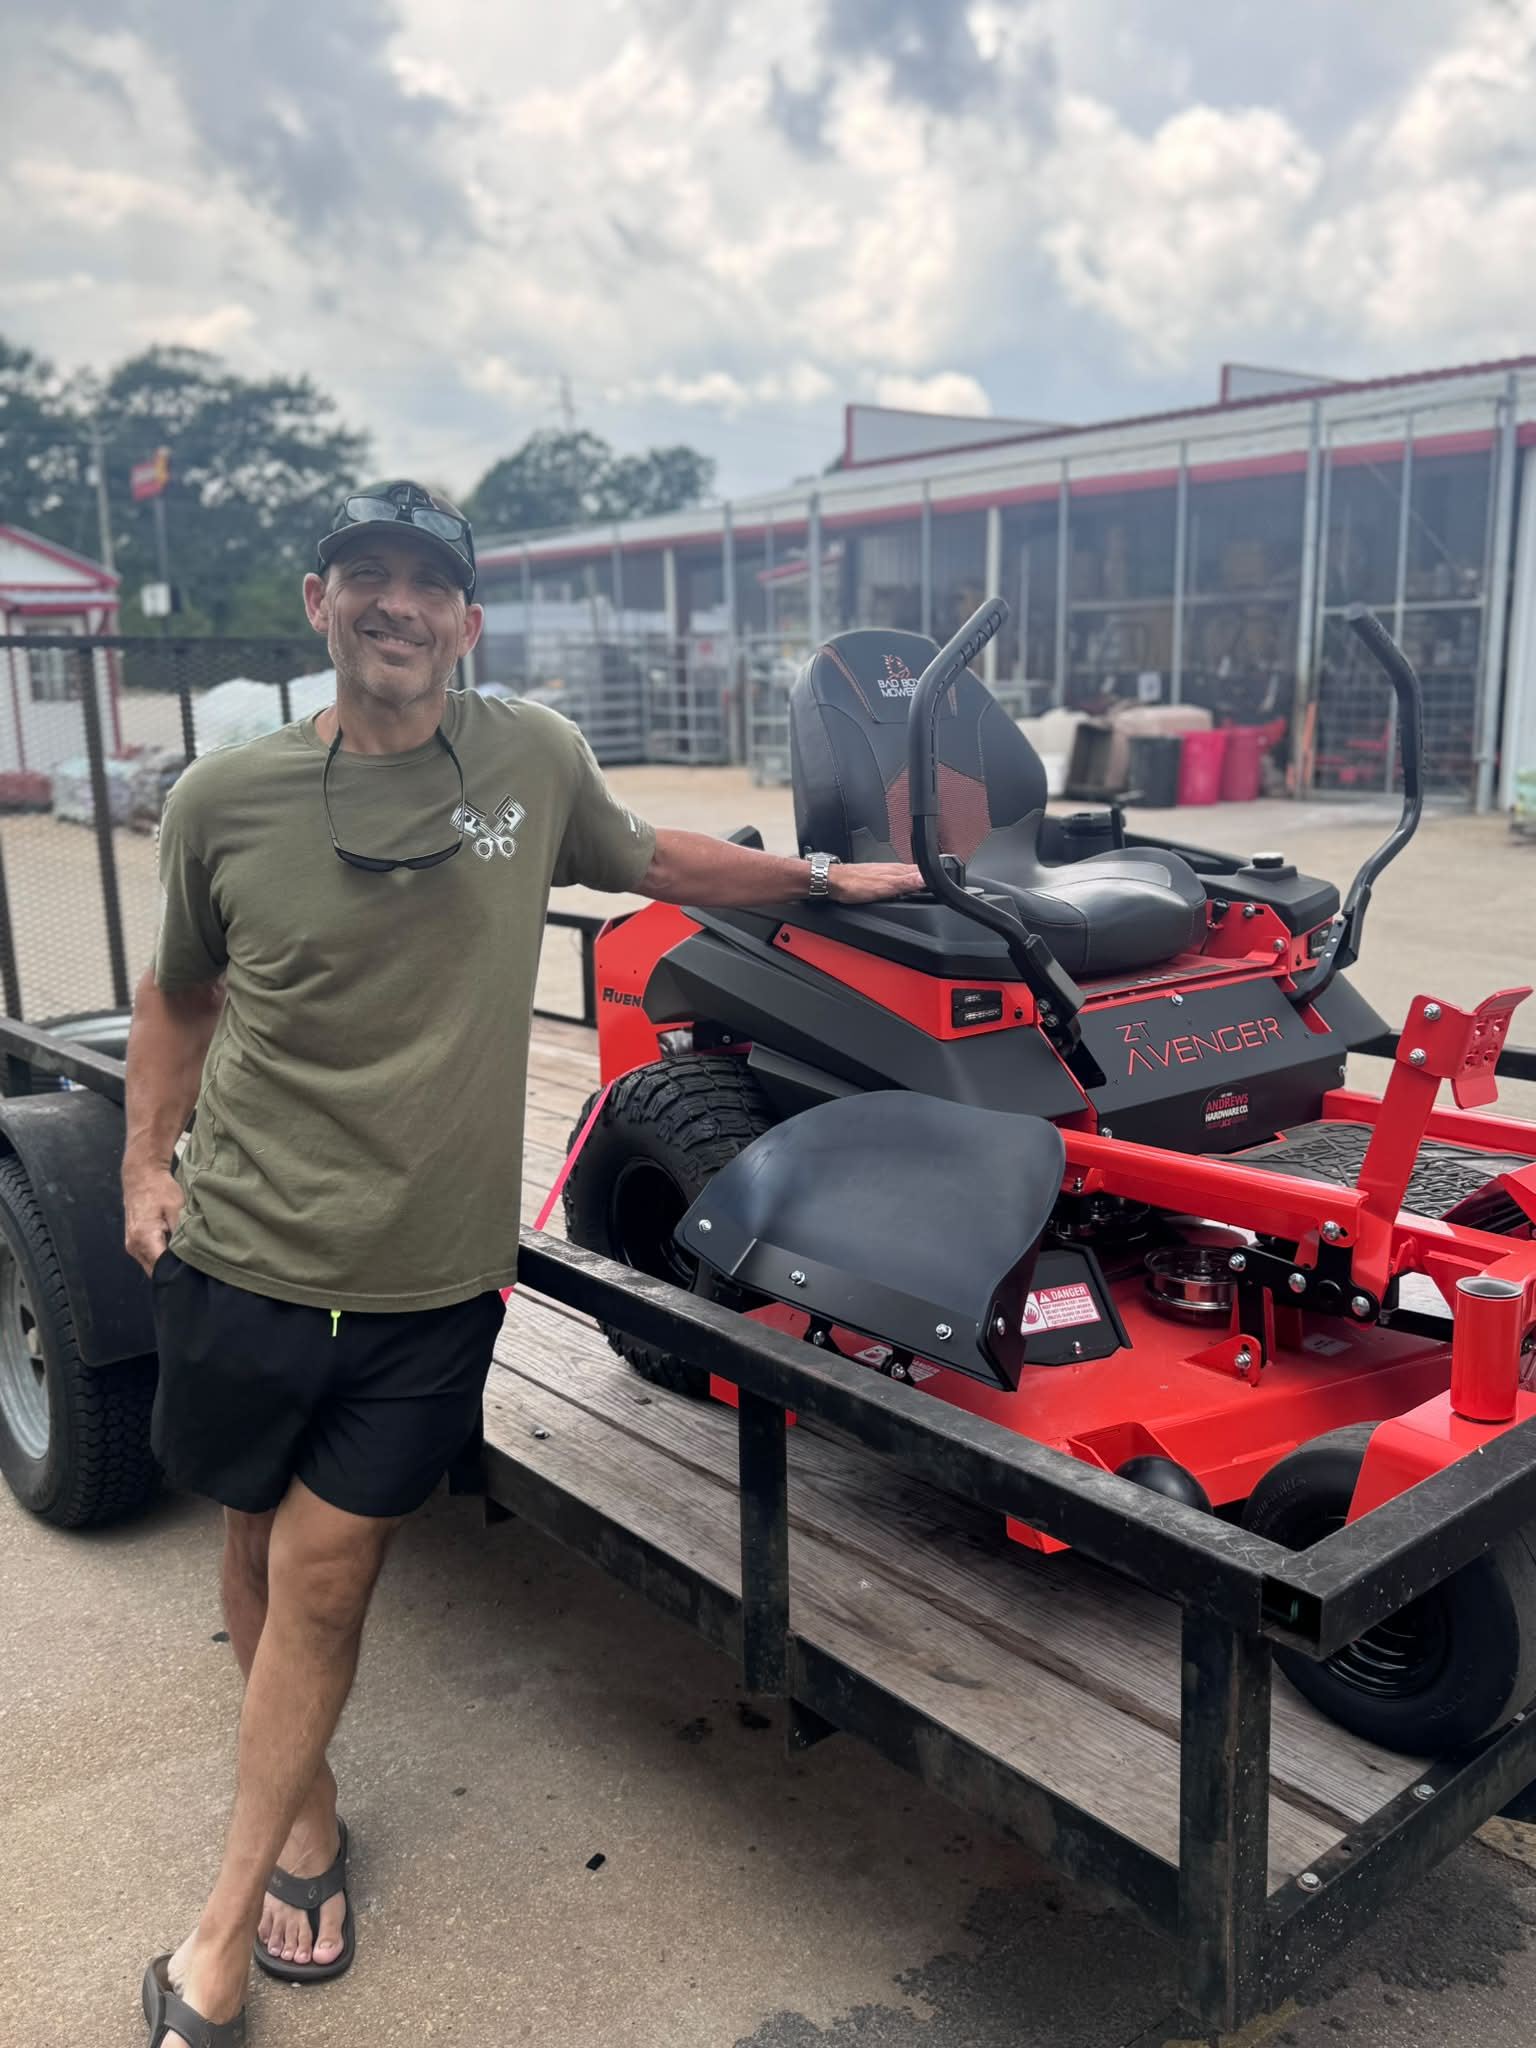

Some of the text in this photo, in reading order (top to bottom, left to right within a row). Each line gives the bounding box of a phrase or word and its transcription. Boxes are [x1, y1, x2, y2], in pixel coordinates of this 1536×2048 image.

[877, 679, 899, 688] BAD
[880, 687, 916, 697] MOWE
[1115, 1020, 1151, 1043] ZT
[1128, 1017, 1284, 1076] AVENGER
[1206, 1093, 1249, 1112] ANDREWS
[1205, 1107, 1239, 1122] HARDWARE
[1051, 1286, 1087, 1300] DANGER
